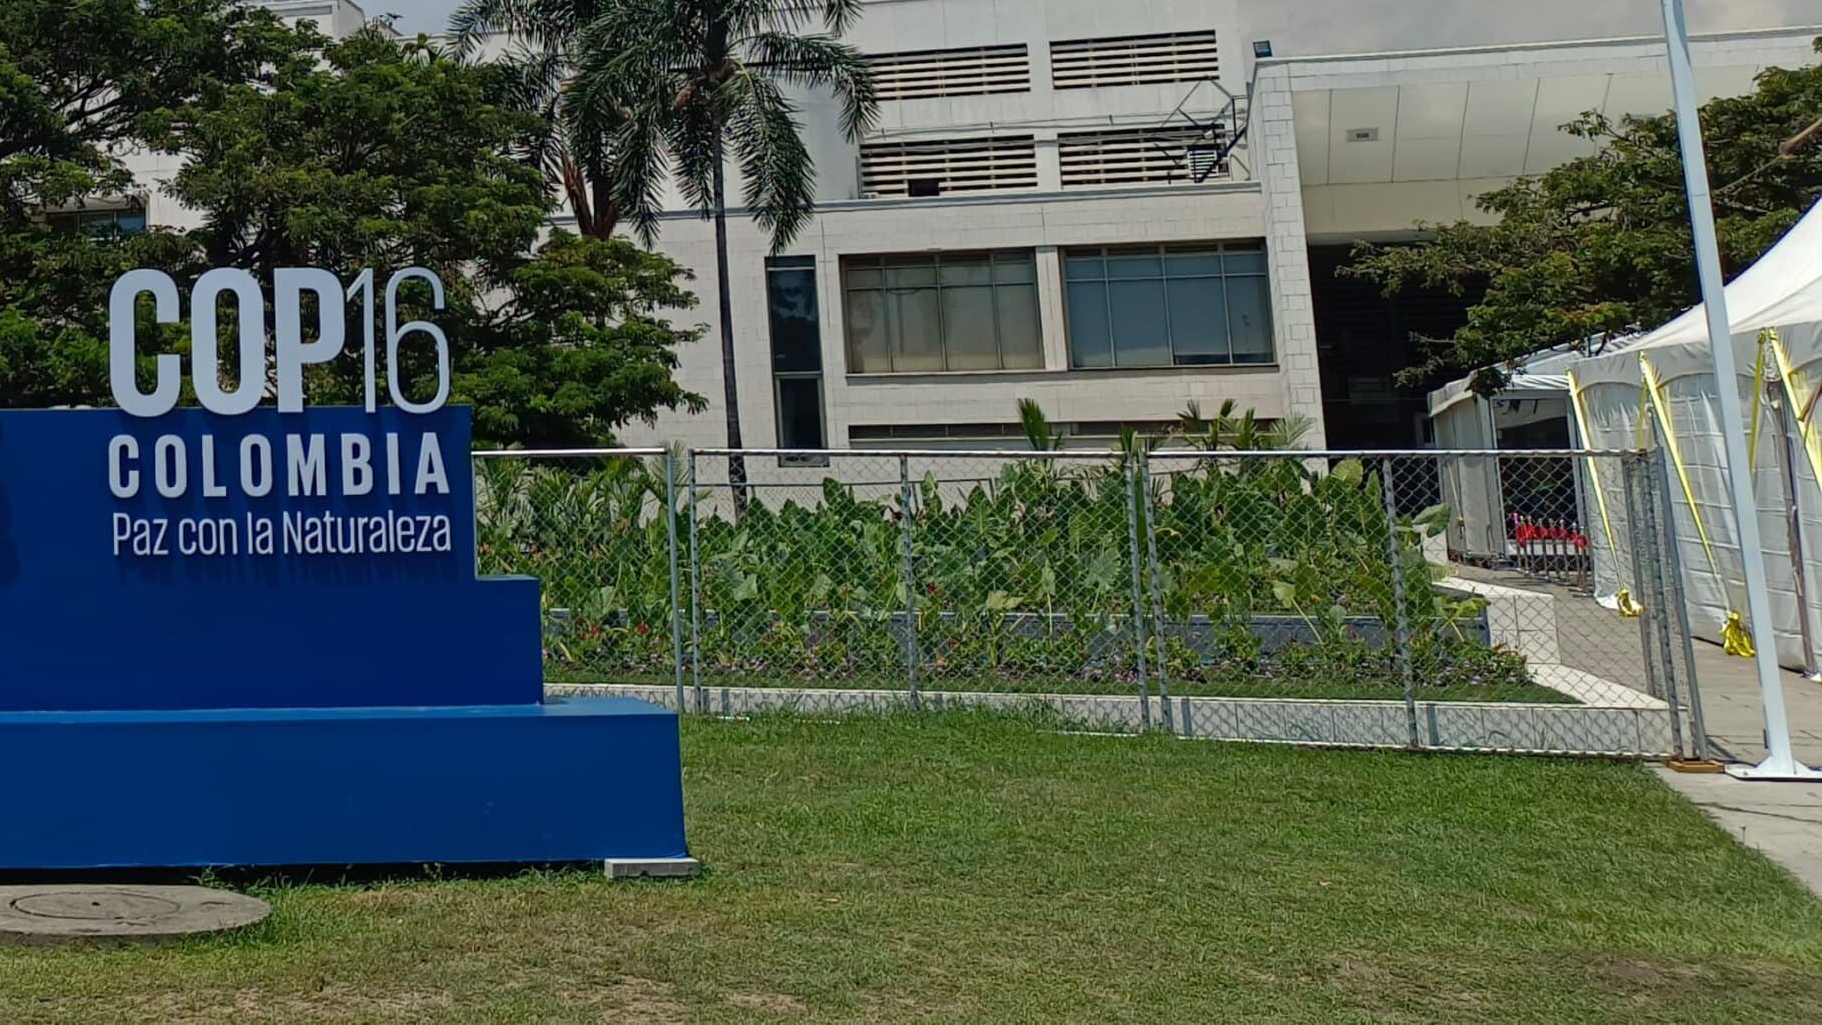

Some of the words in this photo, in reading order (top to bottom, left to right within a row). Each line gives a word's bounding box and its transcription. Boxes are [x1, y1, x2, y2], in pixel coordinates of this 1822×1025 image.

[109, 268, 450, 417] COP16
[108, 432, 450, 498] COLOMBIA
[113, 512, 169, 555] Paz
[178, 517, 238, 555] con
[247, 512, 274, 555] la
[283, 510, 451, 555] Naturaleza
